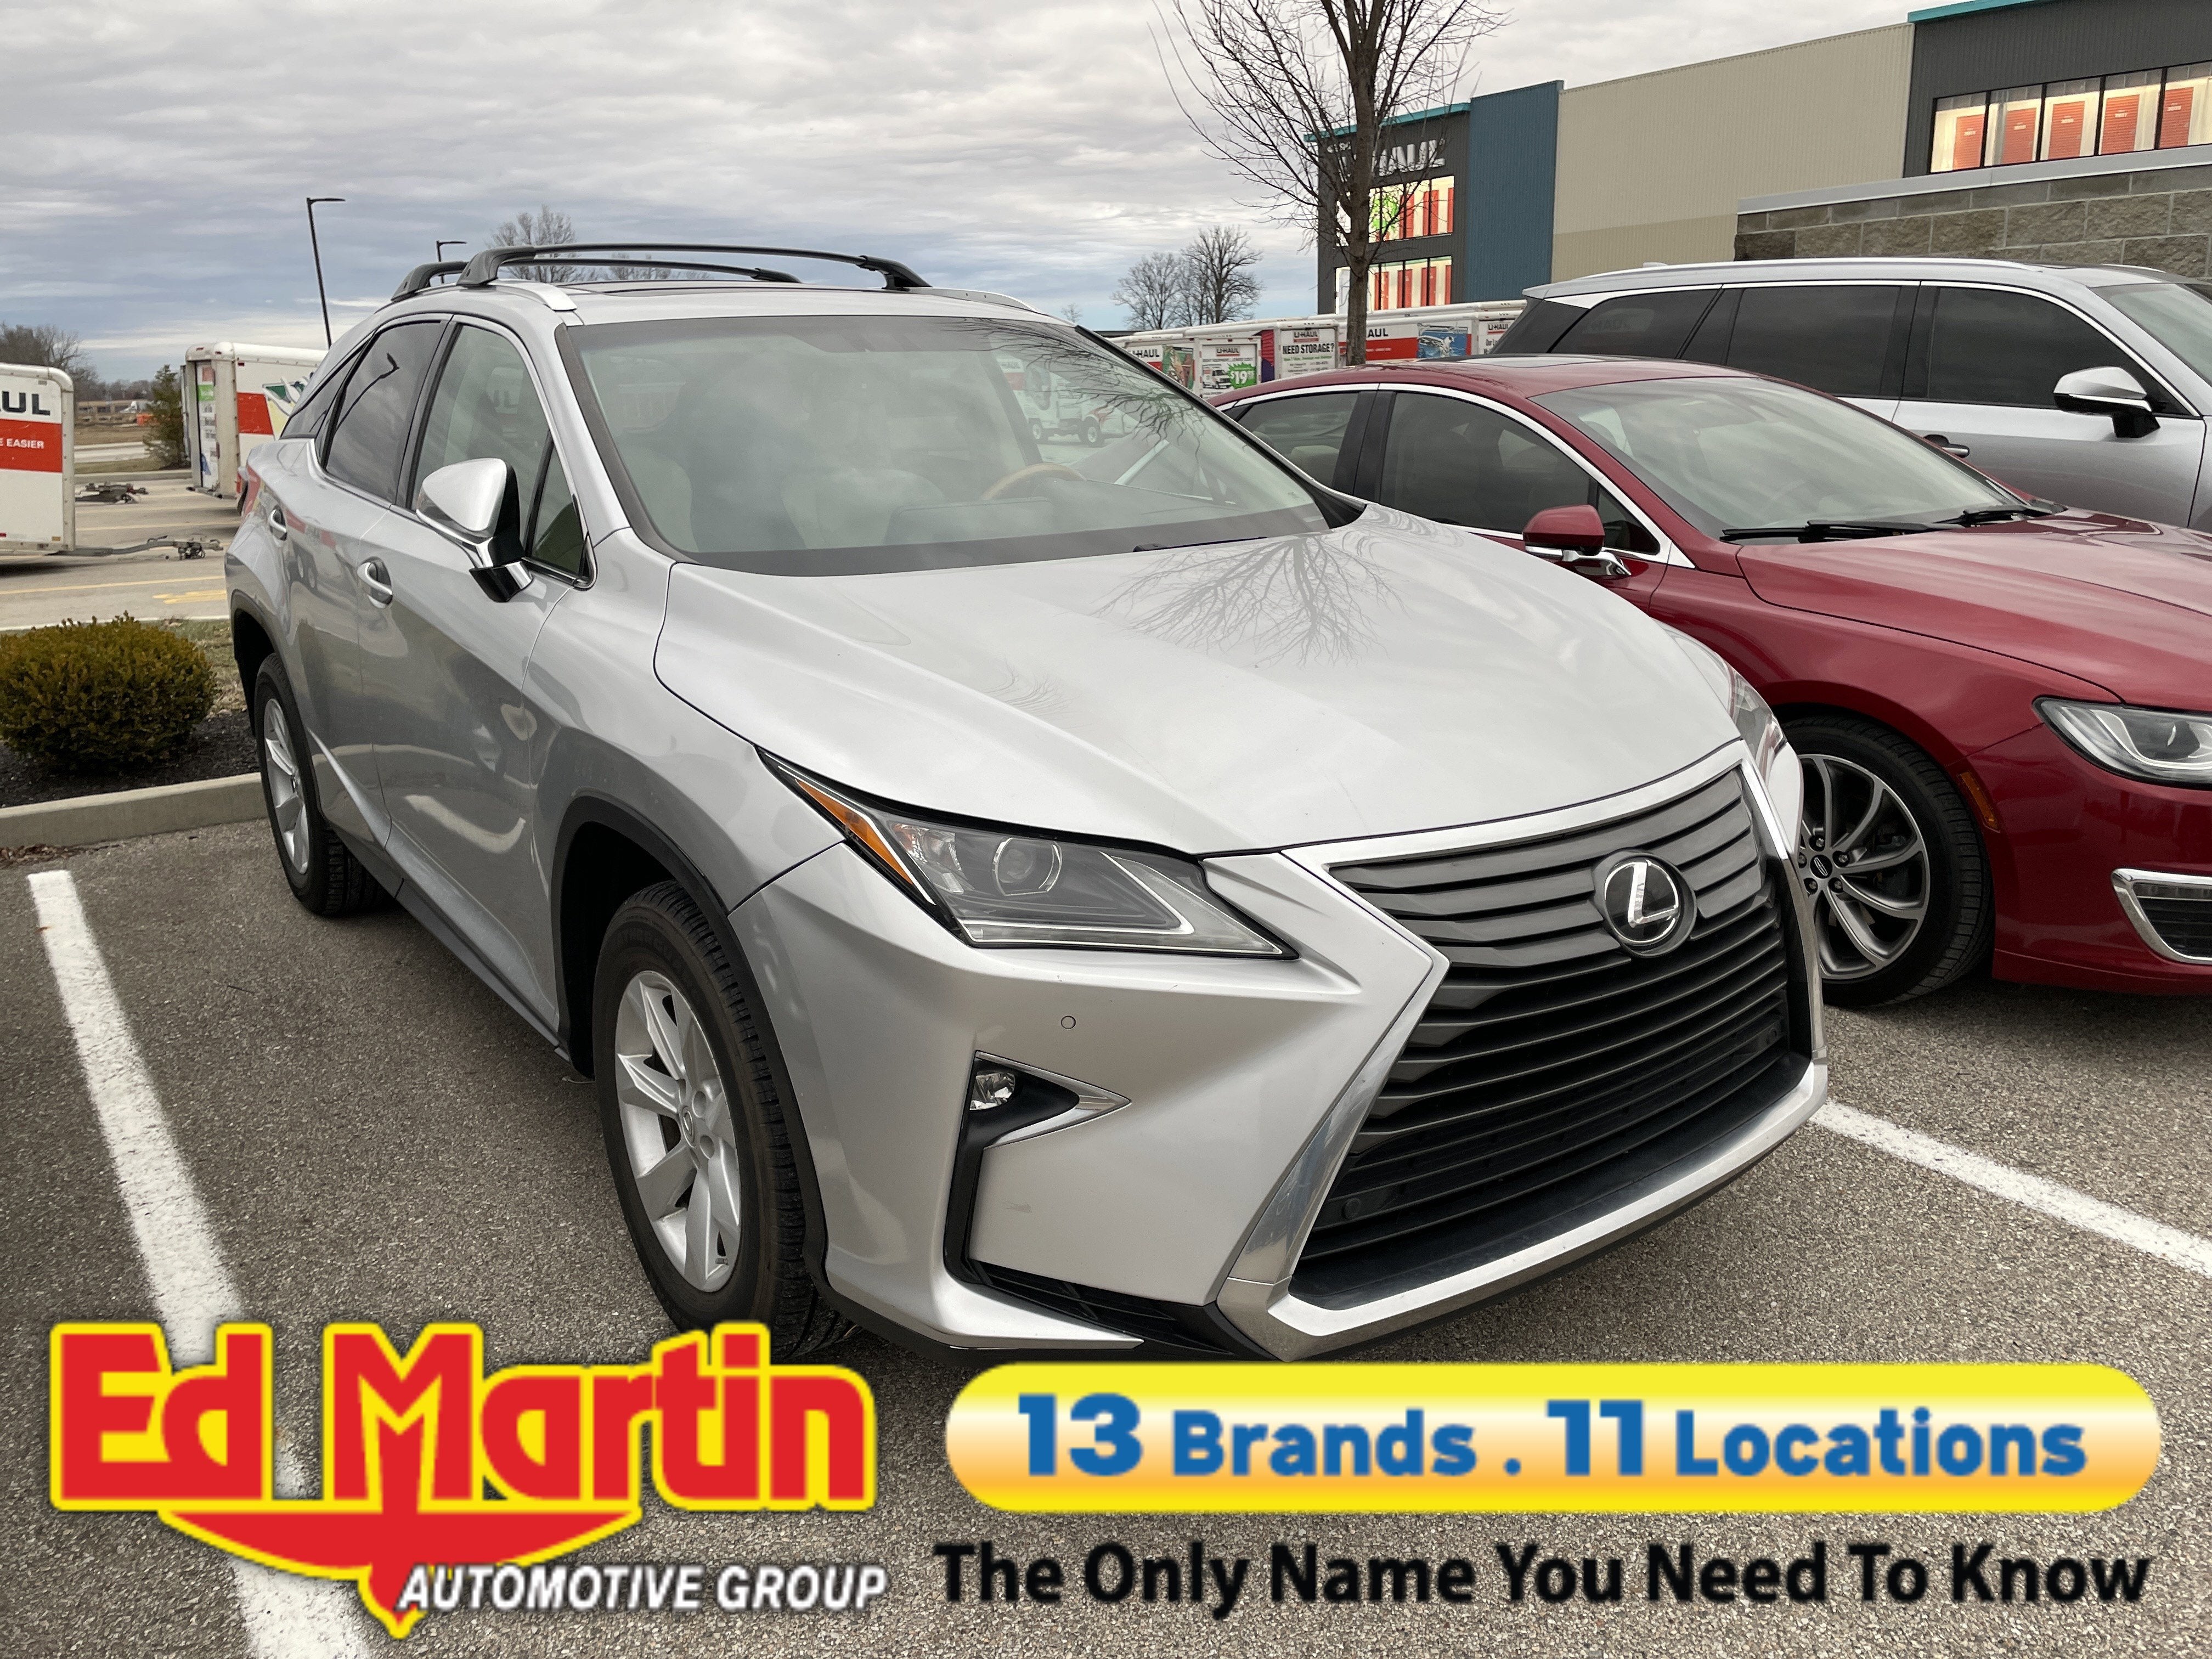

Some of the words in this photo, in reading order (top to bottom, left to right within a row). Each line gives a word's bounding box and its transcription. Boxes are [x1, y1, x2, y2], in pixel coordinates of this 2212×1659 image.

[1282, 345, 1300, 354] NEED
[1301, 343, 1334, 354] STORAGE?
[0, 391, 50, 416] UL
[6, 438, 44, 449] EASIER
